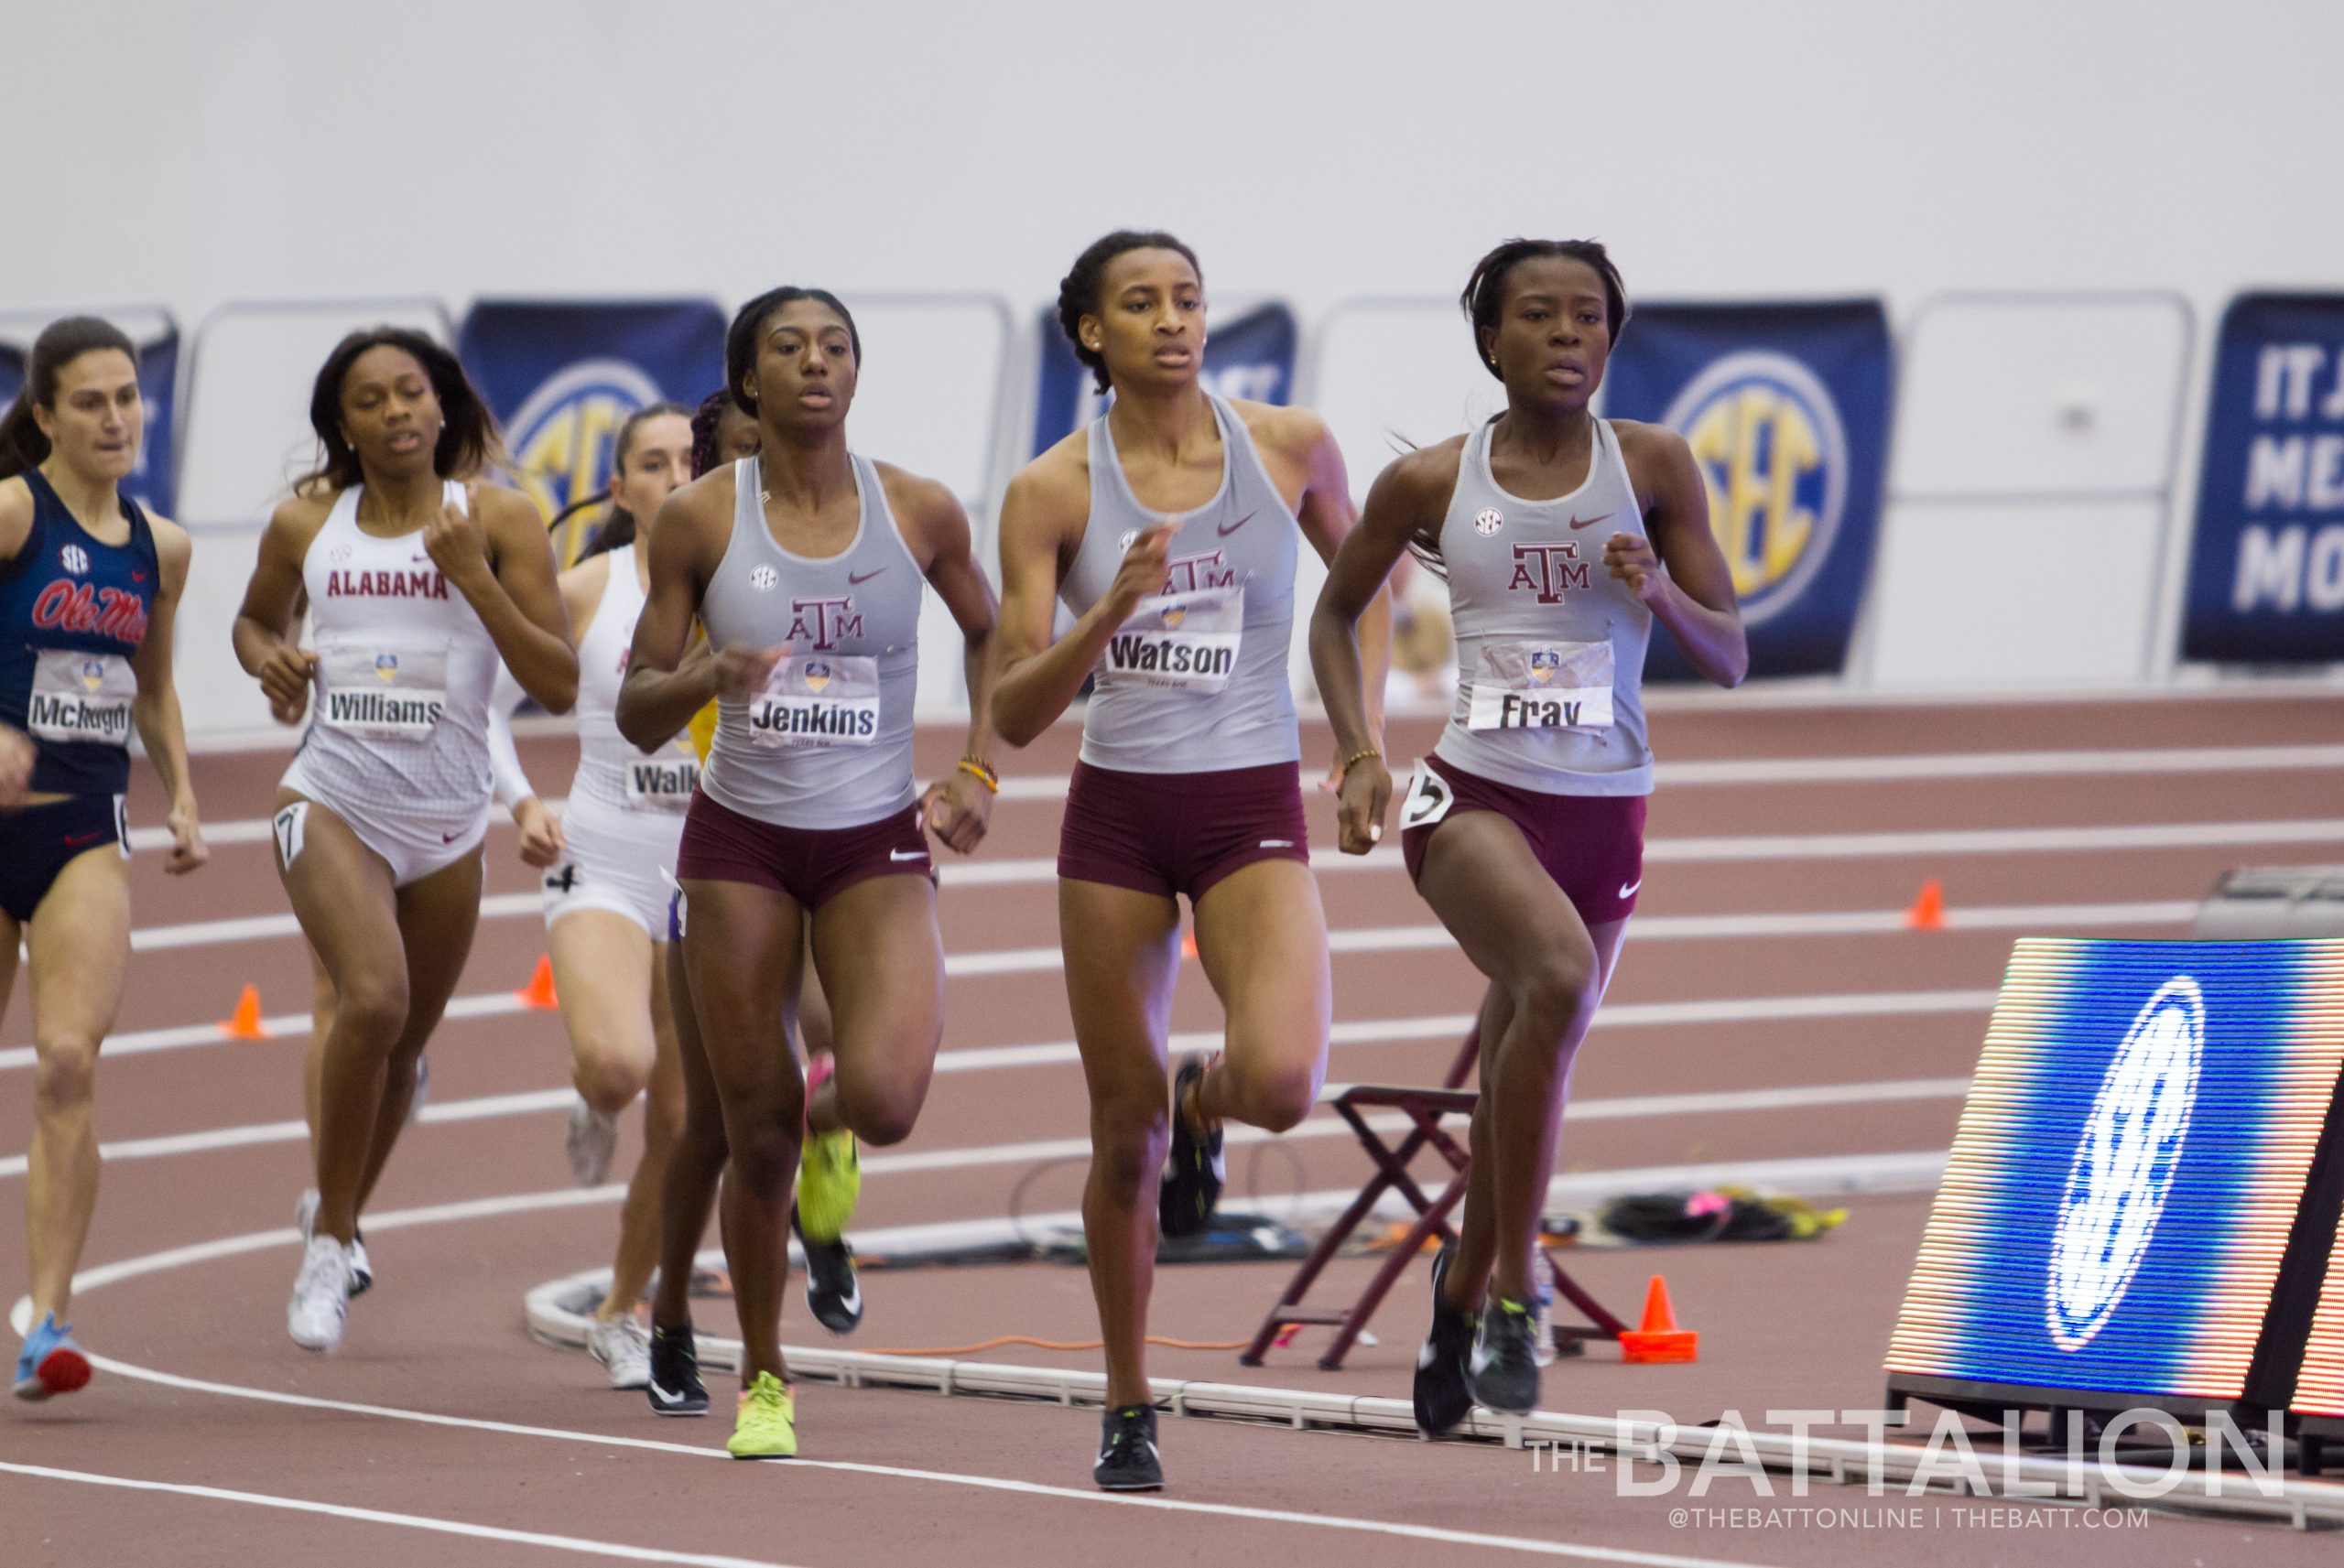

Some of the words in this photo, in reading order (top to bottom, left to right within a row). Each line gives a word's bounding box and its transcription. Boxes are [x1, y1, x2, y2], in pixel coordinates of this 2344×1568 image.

[2254, 344, 2327, 418] IT
[1475, 508, 1503, 536] SEC
[327, 571, 449, 600] ALABAMA
[32, 578, 100, 633] Ole
[1111, 633, 1232, 676] Watson
[331, 692, 442, 724] Williams
[752, 700, 874, 736] Jenkins
[1409, 774, 1443, 822] 5
